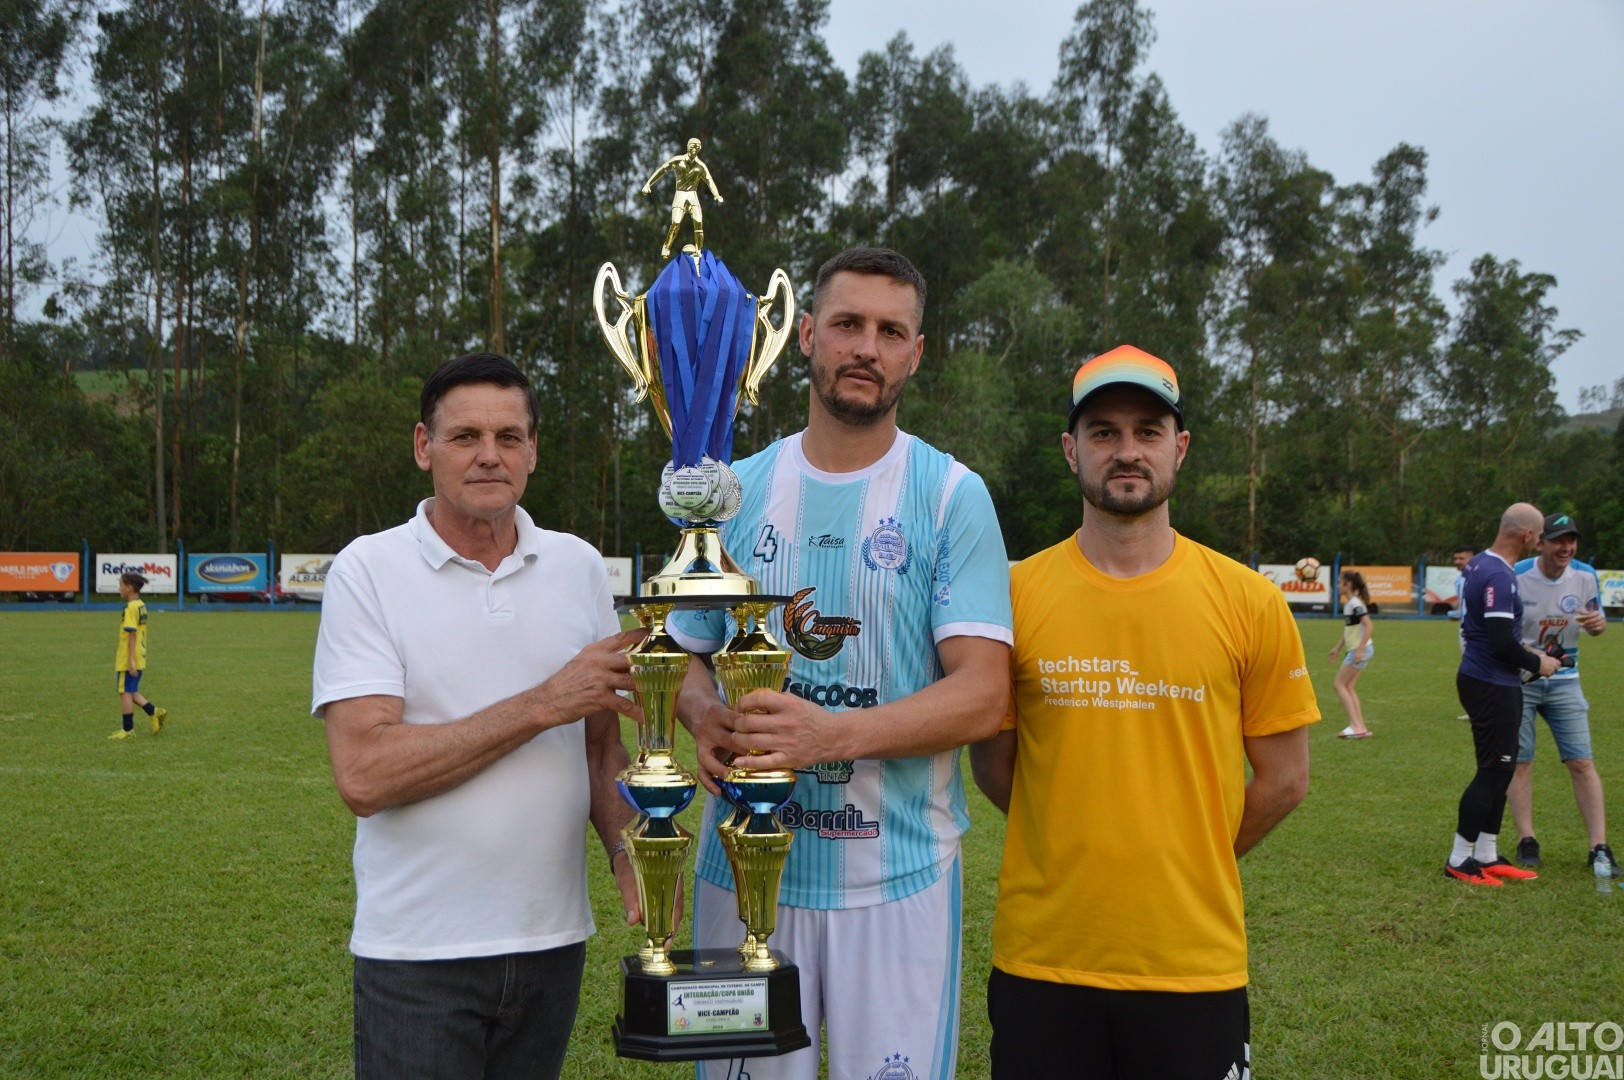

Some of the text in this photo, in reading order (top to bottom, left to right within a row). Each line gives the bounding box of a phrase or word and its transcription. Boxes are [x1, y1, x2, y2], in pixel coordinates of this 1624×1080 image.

[754, 525, 778, 563] 4
[818, 534, 845, 547] Taisa
[800, 610, 861, 640] Conquista
[790, 682, 879, 708] SICOOB
[1040, 676, 1206, 702] Startup Weekend
[1044, 695, 1156, 710] Frederico Westphalen
[819, 771, 849, 781] TINTAS
[820, 829, 878, 838] Supermercado
[697, 1008, 740, 1017] VICE-CAMPEÃO
